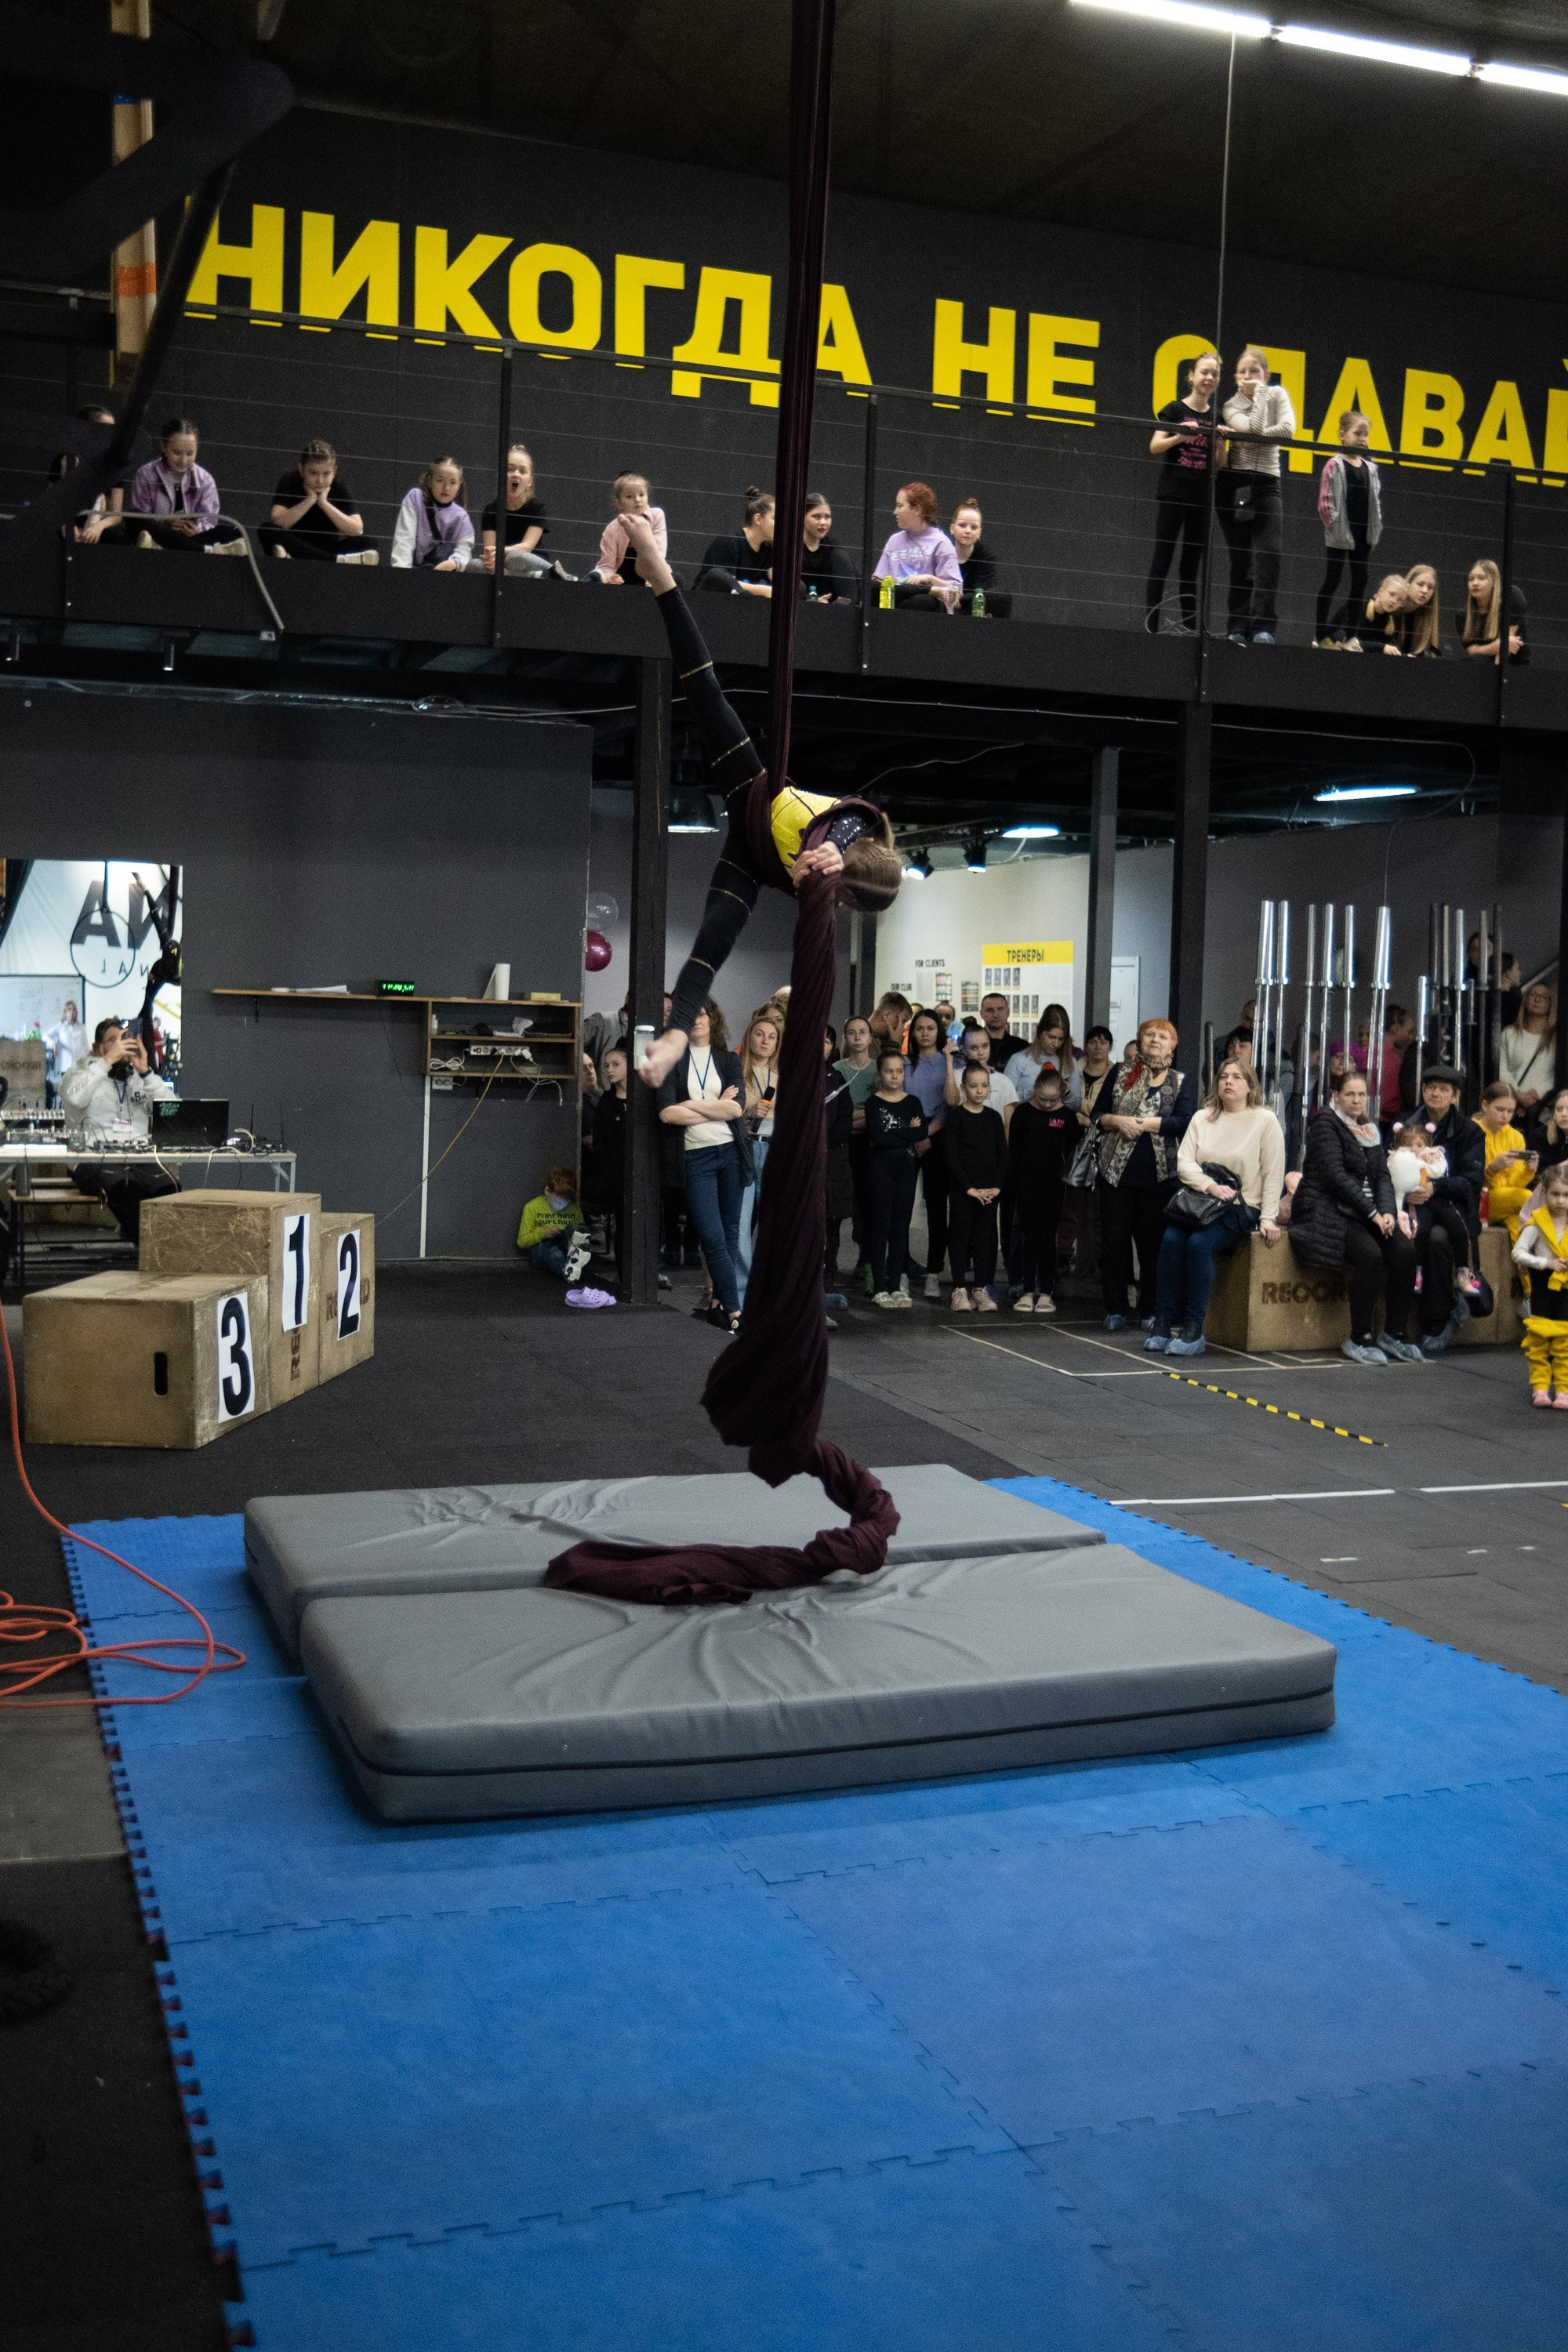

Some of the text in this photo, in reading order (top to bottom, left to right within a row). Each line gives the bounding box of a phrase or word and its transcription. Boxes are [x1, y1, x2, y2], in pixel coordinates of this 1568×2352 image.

[184, 195, 1568, 488] НИКОГДА НЕ СДАВА
[915, 959, 946, 968] FOR CLIENTS
[1007, 949, 1044, 963] ТРЕНЕРЫ
[289, 1214, 305, 1326] 1
[339, 1232, 360, 1339] 2
[221, 1297, 252, 1416] 3
